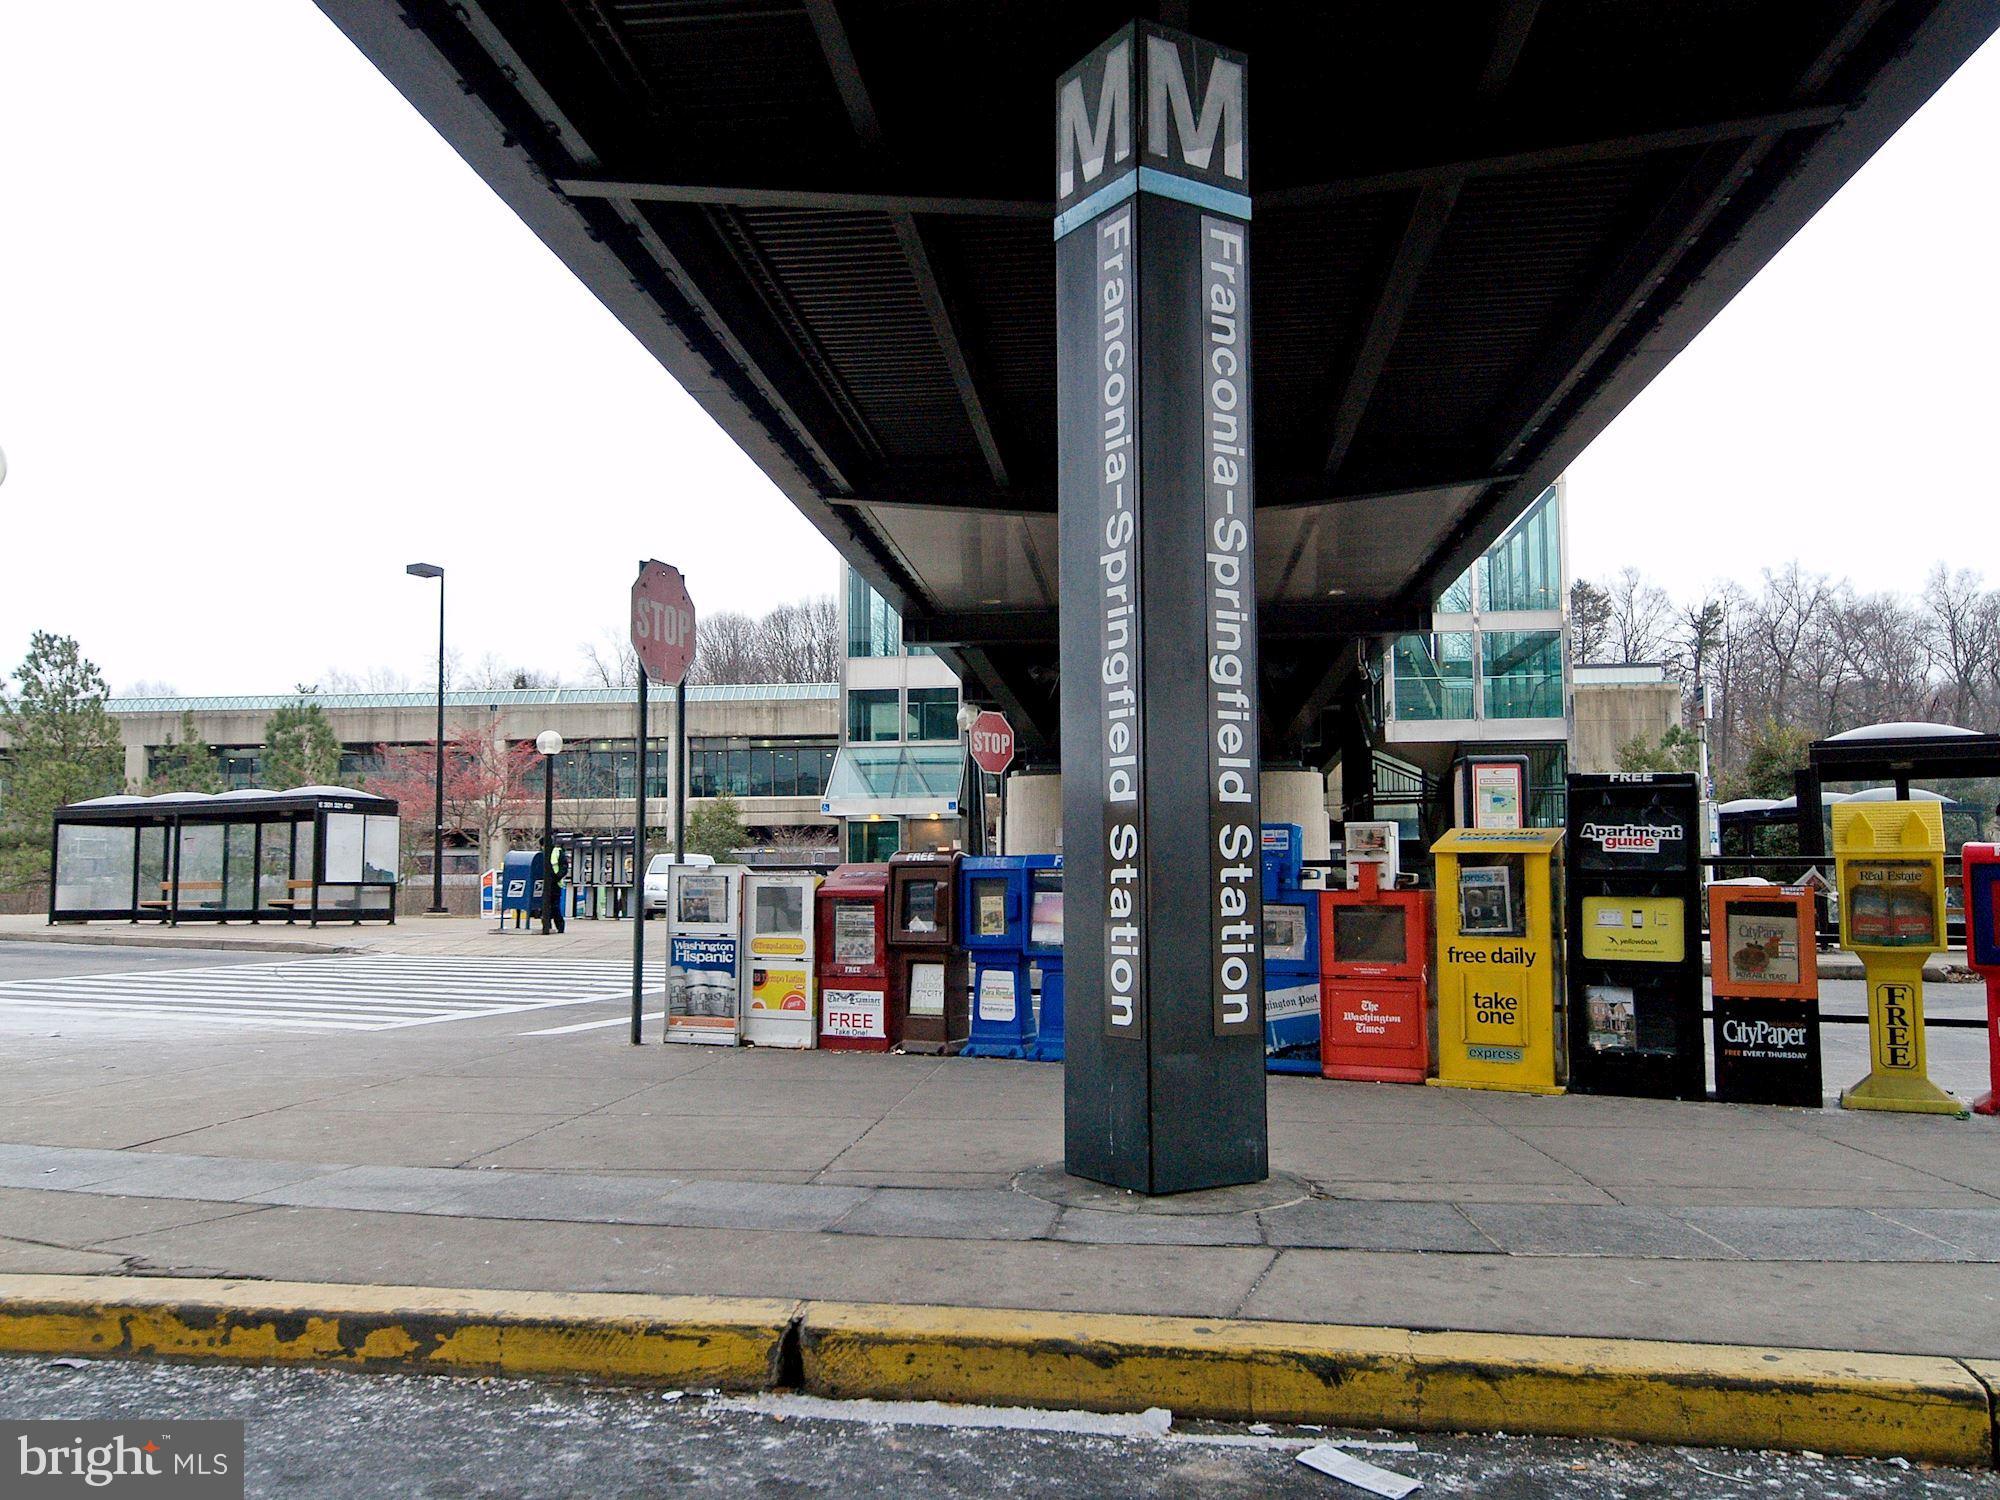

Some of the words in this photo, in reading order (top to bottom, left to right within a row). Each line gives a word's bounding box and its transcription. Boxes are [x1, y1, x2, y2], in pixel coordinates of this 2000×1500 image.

[1147, 34, 1243, 180] M
[1060, 39, 1130, 200] M
[636, 596, 691, 648] STOP
[973, 731, 1010, 754] STOP
[1609, 774, 1654, 782] FREE
[1582, 824, 1681, 838] Apartment
[1605, 833, 1655, 849] guide
[906, 852, 936, 861] FREE
[1860, 871, 1883, 880] Real
[1888, 872, 1922, 882] Estate
[1109, 824, 1138, 1026] Station
[1218, 824, 1254, 1023] Station
[674, 940, 734, 952] Washington
[1620, 938, 1658, 946] yellowbook
[676, 950, 734, 964] Hispanic
[1448, 947, 1486, 963] free
[1491, 947, 1537, 968] daily
[1298, 994, 1318, 1007] Post
[1361, 1000, 1379, 1012] The
[1473, 992, 1518, 1010] take
[829, 1012, 873, 1028] FREE
[1343, 1012, 1401, 1024] Washington
[1477, 1010, 1515, 1025] one
[852, 1028, 868, 1036] One!
[1356, 1022, 1385, 1034] Times
[1884, 986, 1910, 1067] FREE
[1722, 1020, 1807, 1048] CityPaper
[1469, 1048, 1521, 1060] express
[1742, 1050, 1766, 1058] EVERY
